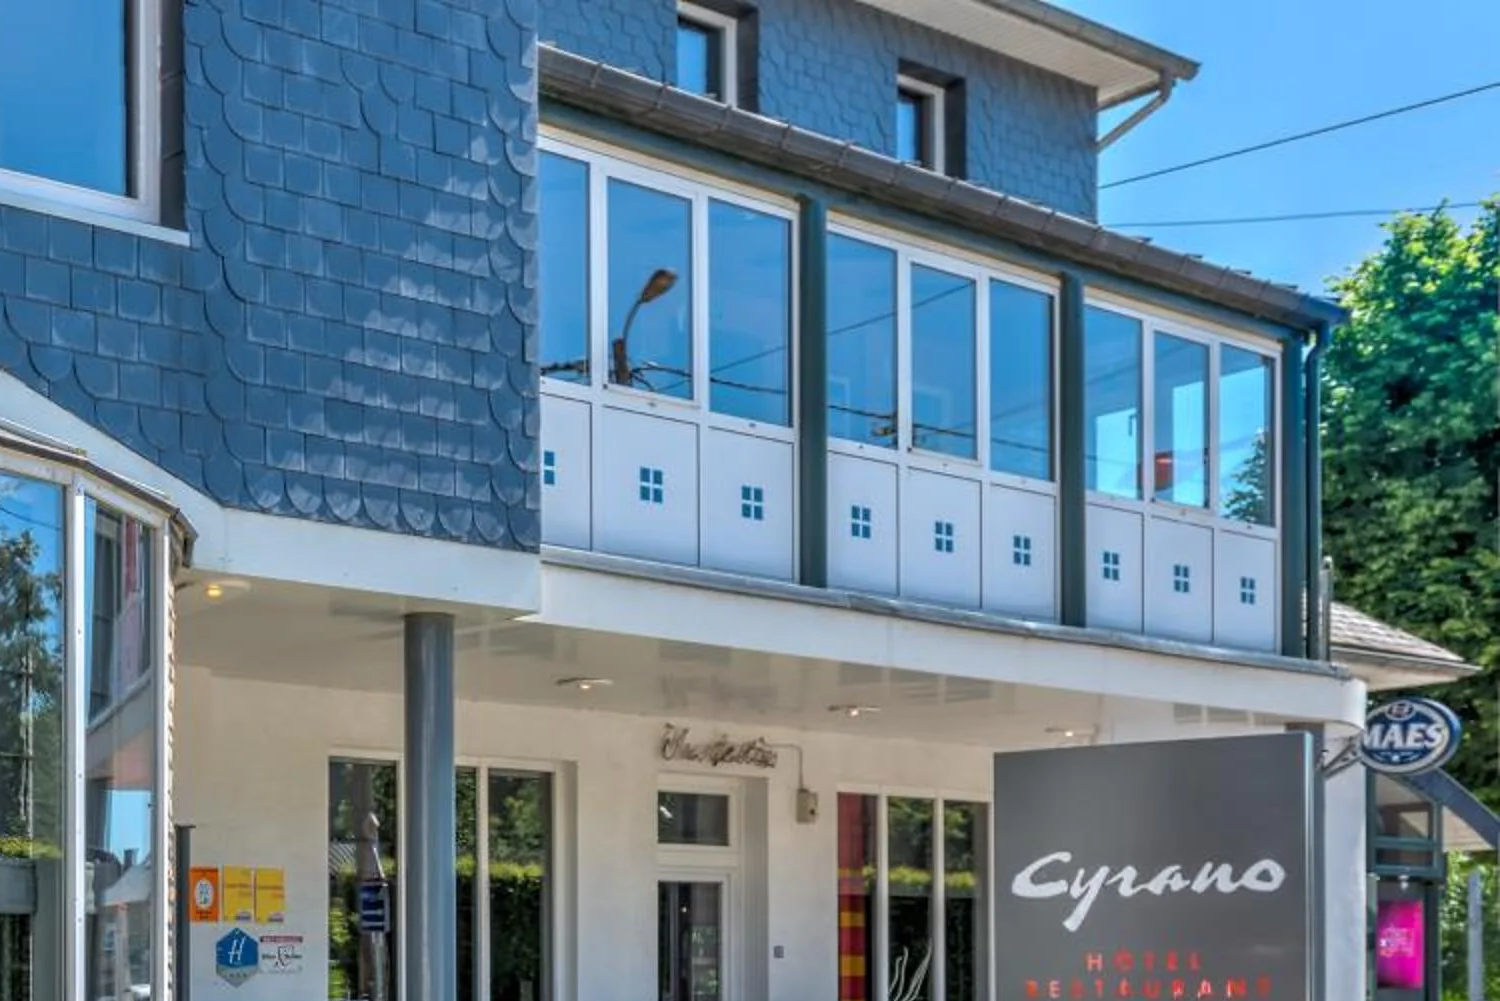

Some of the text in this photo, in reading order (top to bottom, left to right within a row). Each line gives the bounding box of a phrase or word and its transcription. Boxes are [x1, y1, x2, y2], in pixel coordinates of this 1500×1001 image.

[1363, 722, 1444, 748] MAES
[1011, 851, 1286, 932] Cyrano
[1086, 949, 1202, 973] HOTEL
